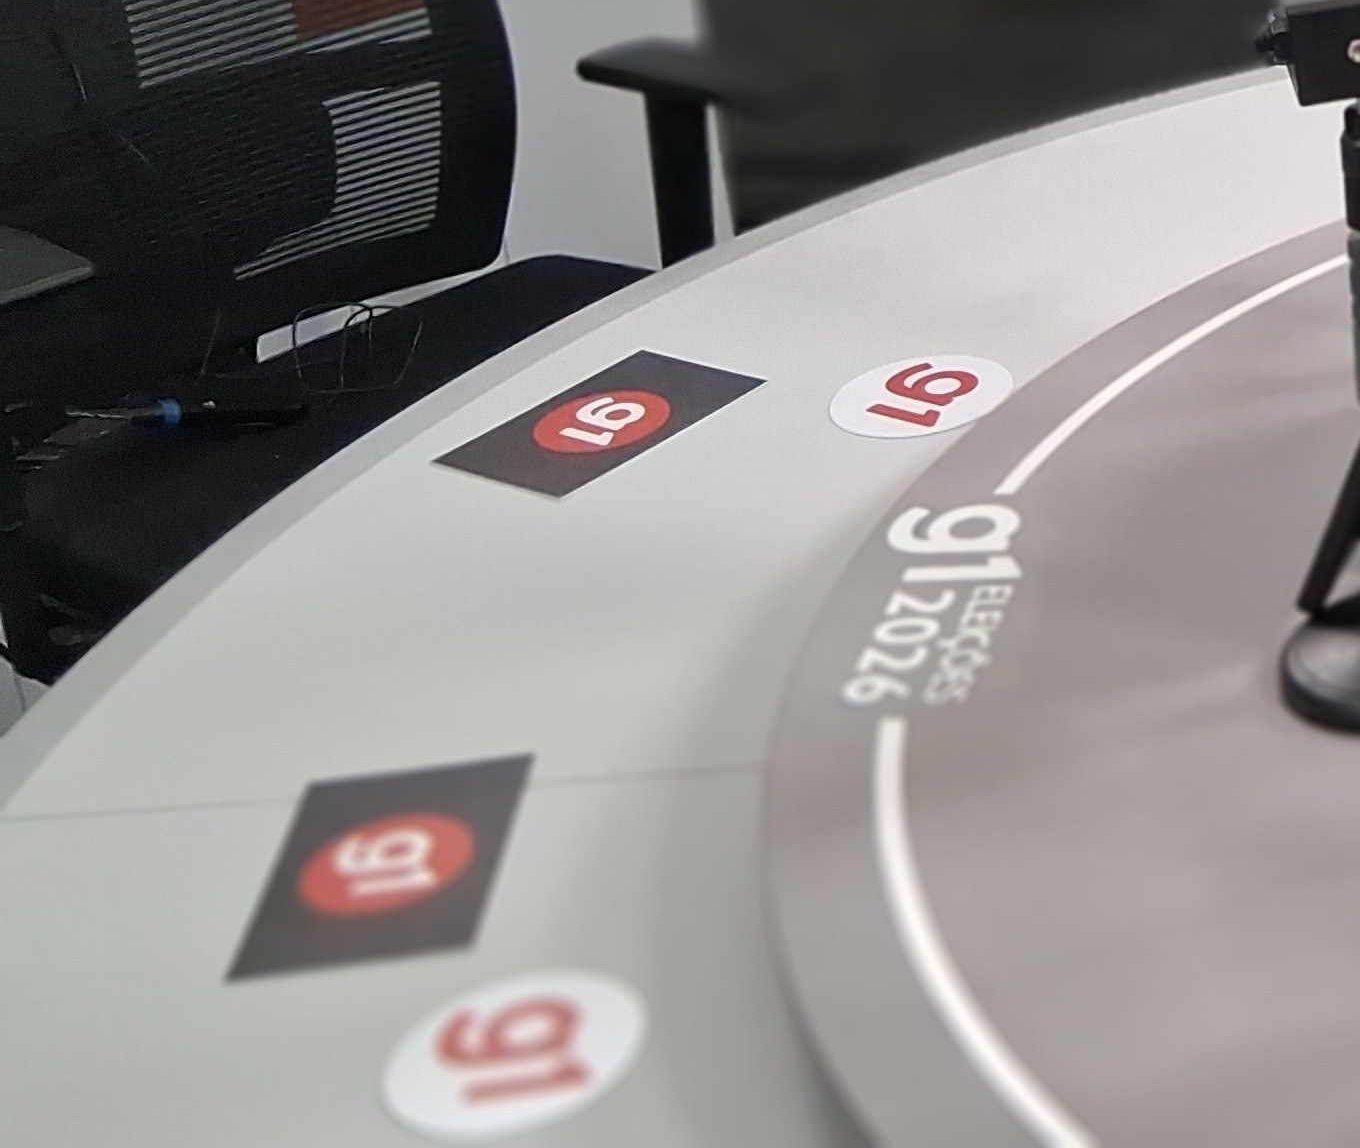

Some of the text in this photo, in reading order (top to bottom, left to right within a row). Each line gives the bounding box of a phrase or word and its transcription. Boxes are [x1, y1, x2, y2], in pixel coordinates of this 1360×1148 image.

[559, 397, 646, 446] g1
[866, 363, 979, 428] g1
[887, 505, 1022, 582] g1
[842, 589, 955, 705] 2026
[332, 829, 438, 898] g1
[434, 995, 593, 1106] g1
